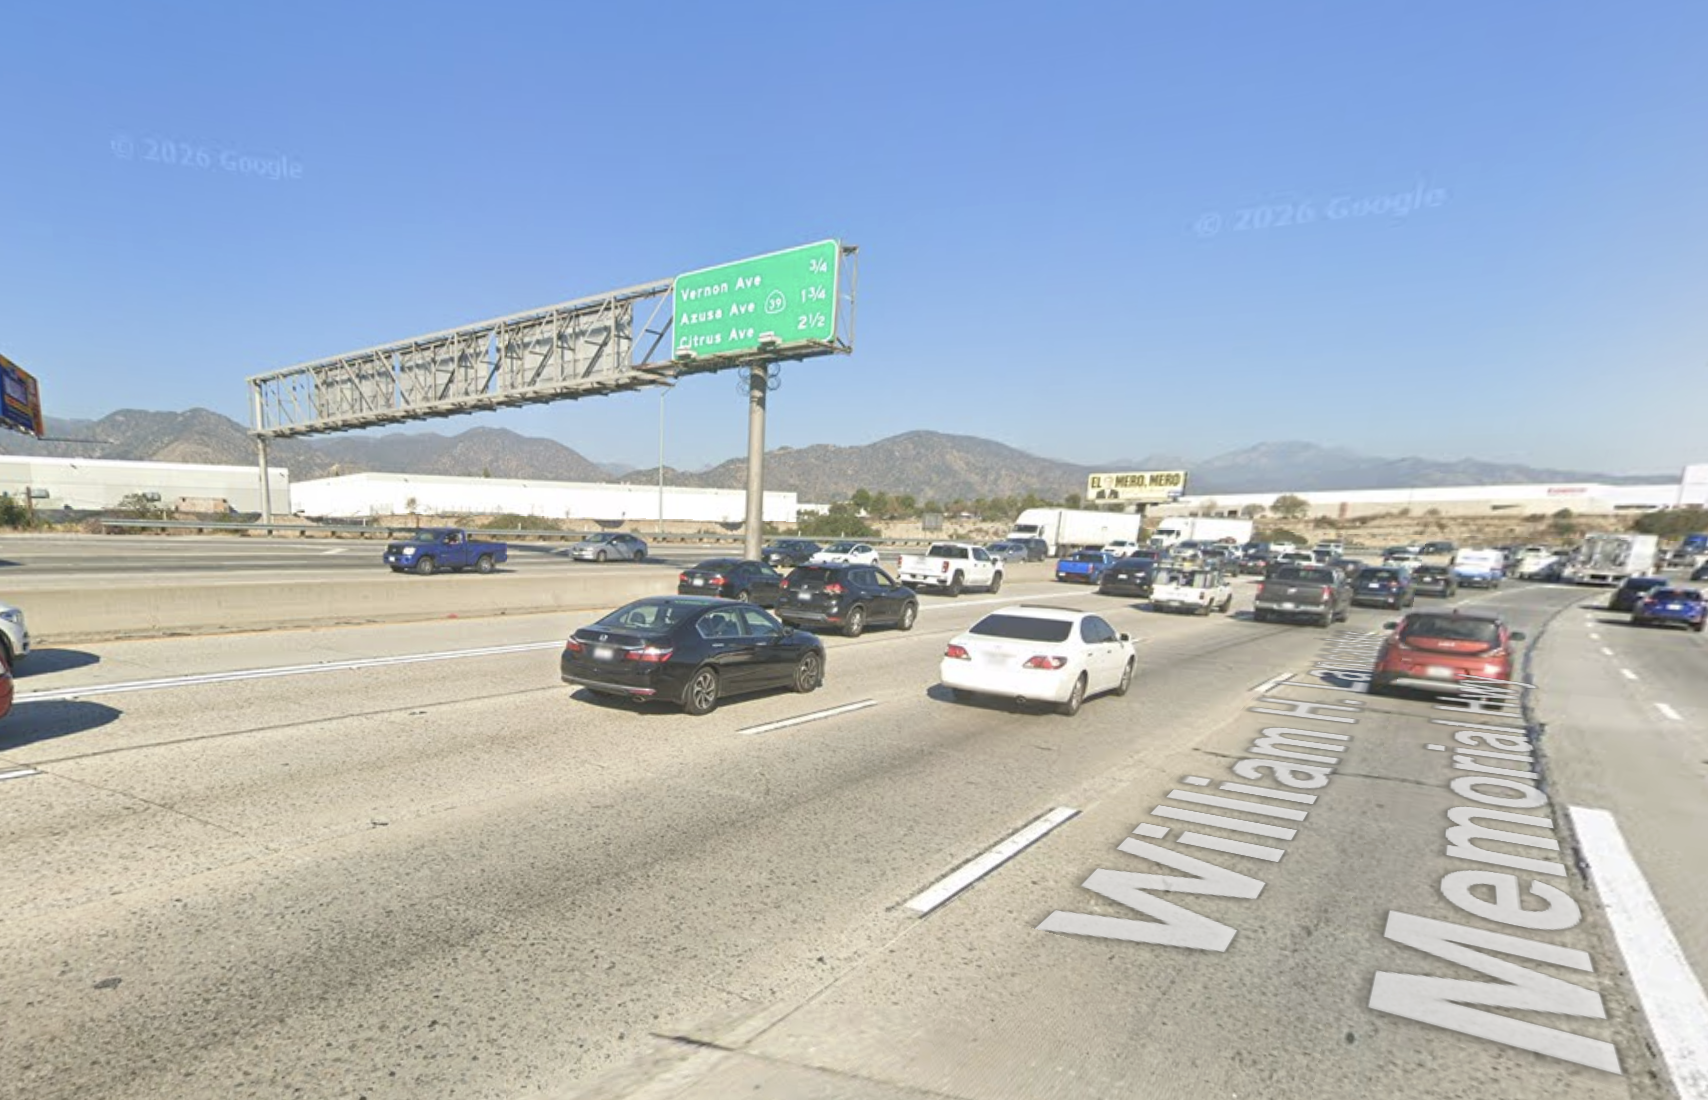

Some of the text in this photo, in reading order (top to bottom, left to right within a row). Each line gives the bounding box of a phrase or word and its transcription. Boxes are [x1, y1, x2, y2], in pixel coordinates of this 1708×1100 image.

[681, 281, 728, 302] Vernon
[735, 274, 762, 291] Ave
[680, 306, 723, 327] Azusa
[729, 301, 755, 317] Ave
[769, 297, 782, 310] 39
[680, 333, 721, 349] Citrus
[728, 327, 754, 342] Ave
[1091, 472, 1181, 489] EL MERO, MERO
